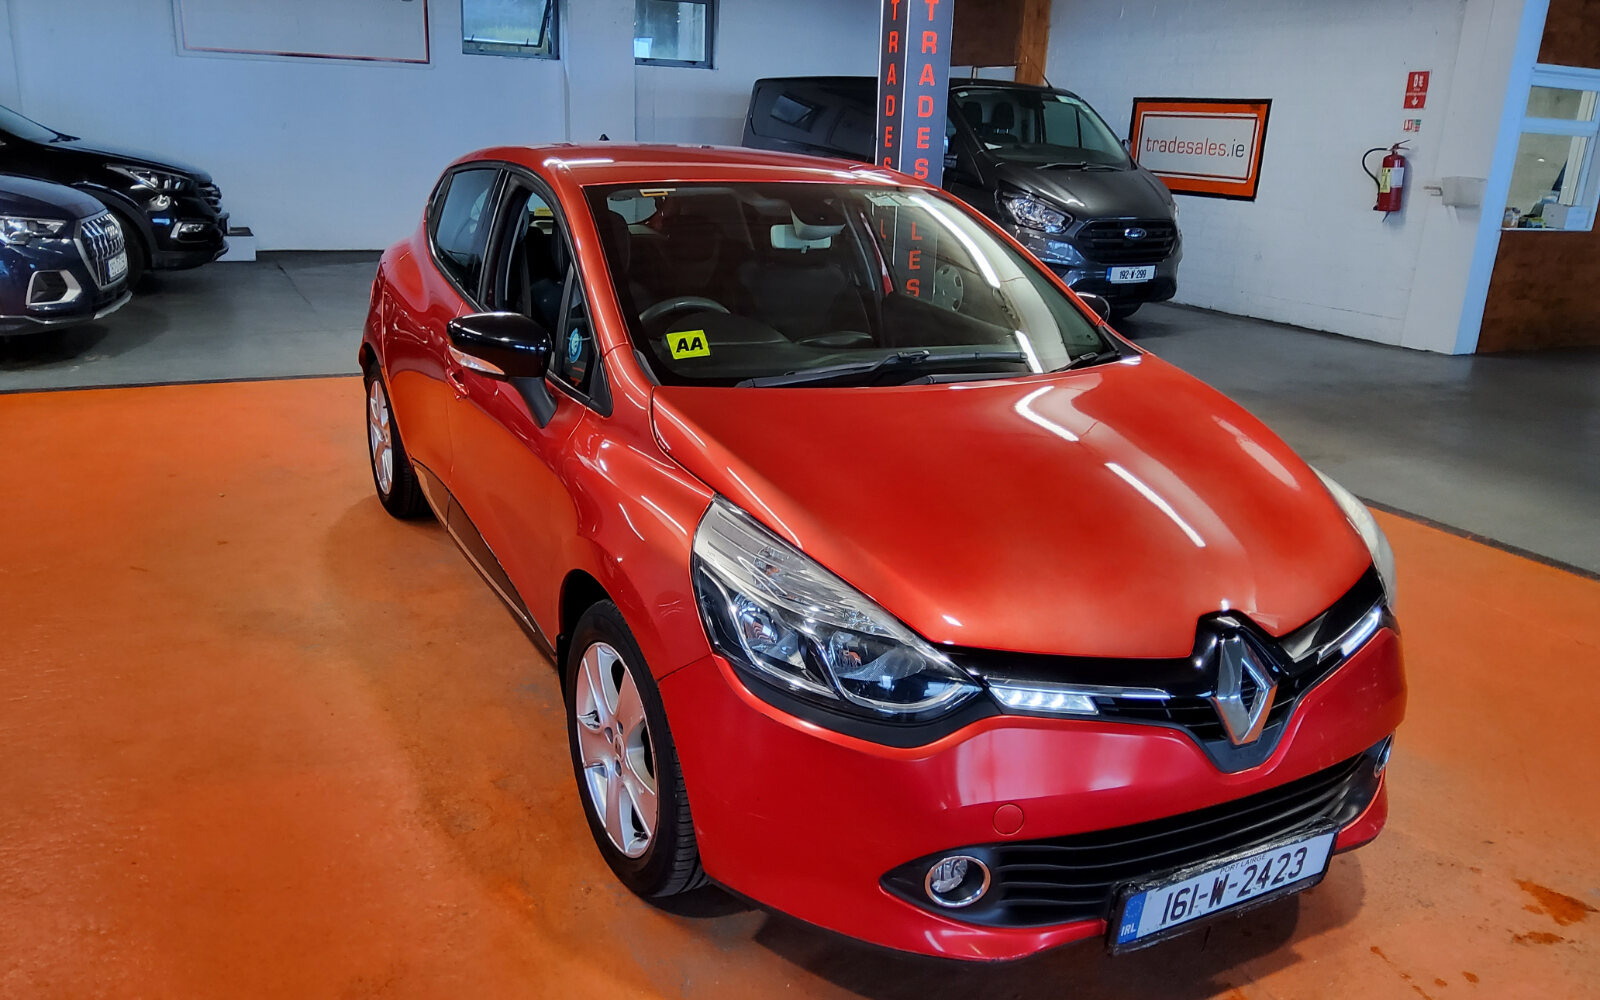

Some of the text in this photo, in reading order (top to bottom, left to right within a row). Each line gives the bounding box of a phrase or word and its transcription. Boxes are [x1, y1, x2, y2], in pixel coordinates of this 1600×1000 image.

[1146, 136, 1245, 158] tradesales.ie
[676, 336, 703, 353] AA
[1220, 862, 1239, 874] PORT
[1159, 847, 1308, 926] 161-W-2423
[1121, 923, 1136, 937] IRL
